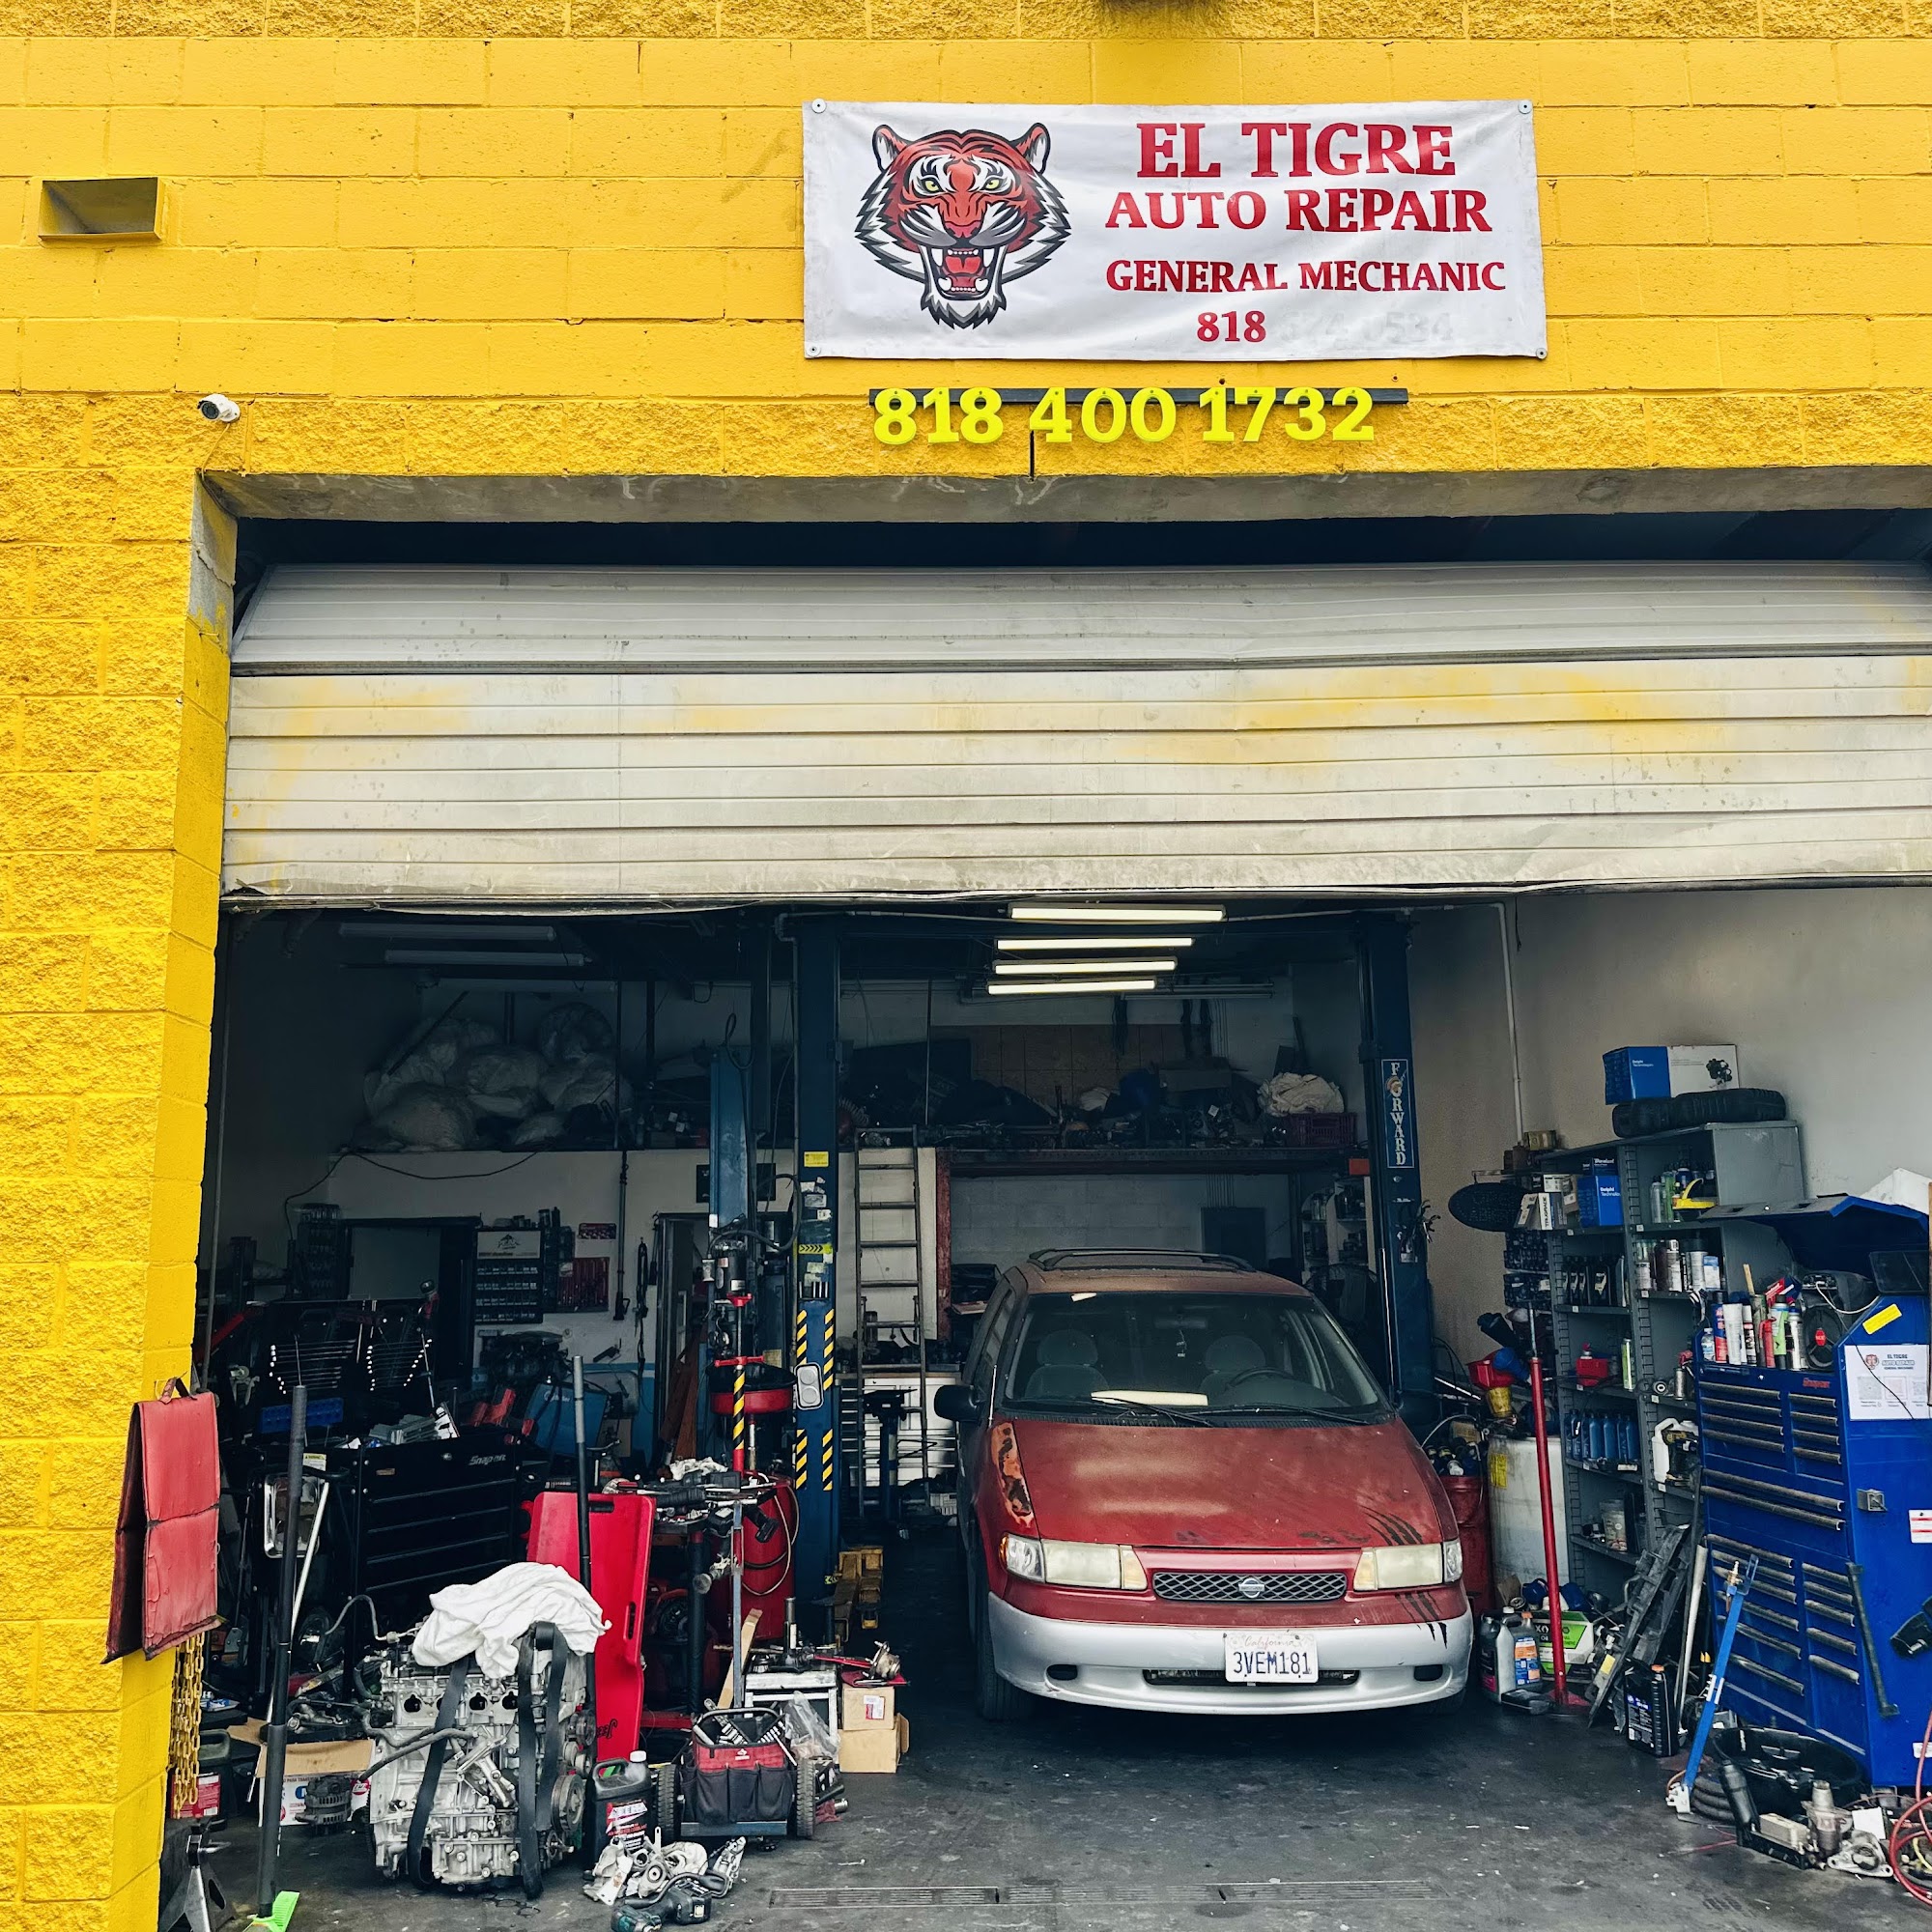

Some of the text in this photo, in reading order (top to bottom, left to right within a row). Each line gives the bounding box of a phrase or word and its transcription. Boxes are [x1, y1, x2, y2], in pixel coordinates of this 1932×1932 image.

[1136, 122, 1456, 179] EL TIGRE
[1105, 187, 1492, 233] AUTO REPAIR
[1105, 259, 1505, 294] GENERAL MECHANIC
[1196, 310, 1266, 343] 818
[873, 386, 1375, 444] 818 400 1732
[1390, 1062, 1407, 1166] FORWARD
[1233, 1651, 1311, 1675] 3VEM181
